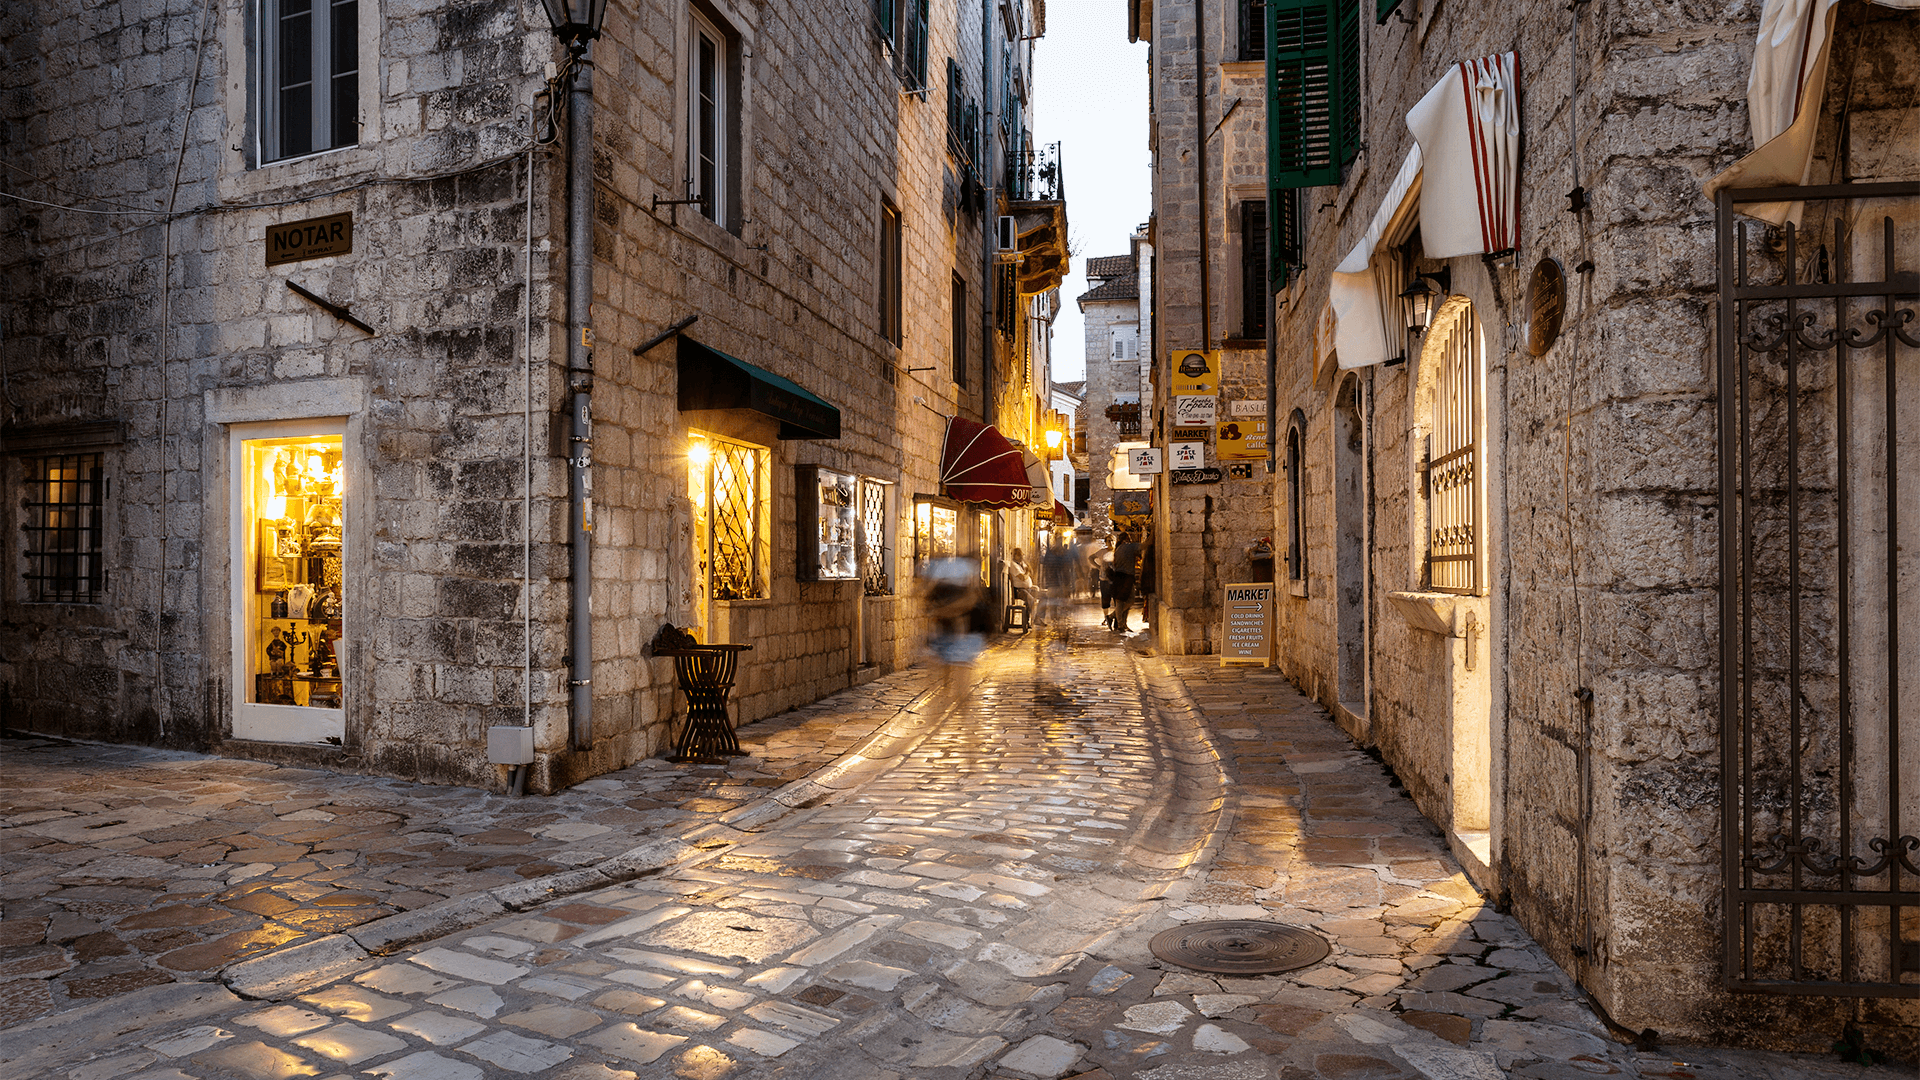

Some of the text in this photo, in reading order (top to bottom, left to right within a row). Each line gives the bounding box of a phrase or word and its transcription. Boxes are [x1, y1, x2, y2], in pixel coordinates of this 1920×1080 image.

[274, 221, 344, 252] NOTAR
[307, 246, 334, 255] SPRAT
[1178, 398, 1214, 412] Trpeza
[1174, 429, 1209, 438] MARKET
[1228, 589, 1270, 601] MARKET
